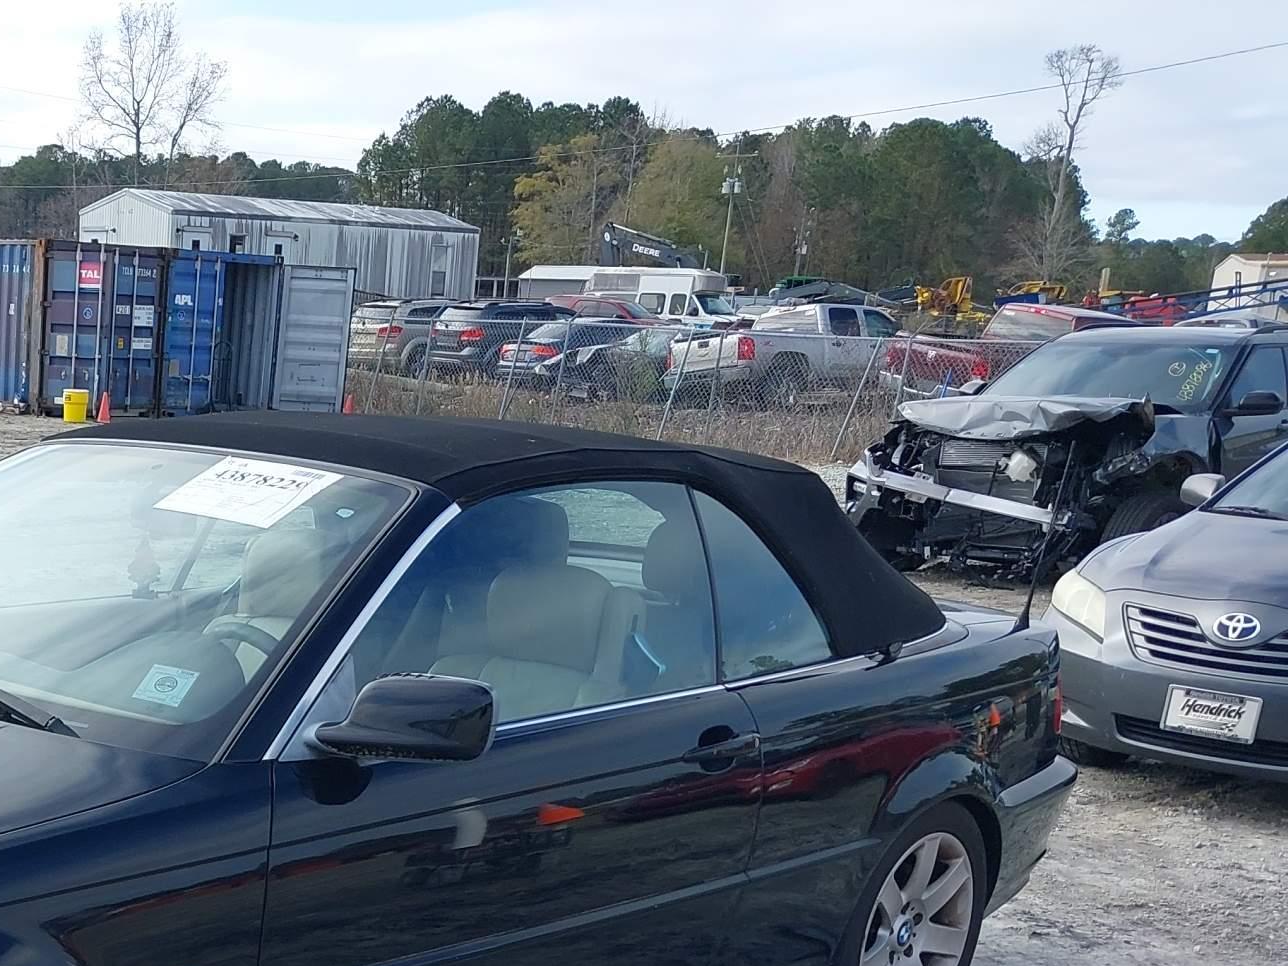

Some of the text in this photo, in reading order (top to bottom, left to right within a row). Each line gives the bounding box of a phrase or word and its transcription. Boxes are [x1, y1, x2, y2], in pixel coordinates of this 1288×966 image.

[632, 243, 661, 257] DEERE
[80, 269, 101, 279] TAL
[174, 294, 194, 306] APL
[215, 469, 310, 490] 43878229
[1180, 698, 1247, 720] Hendrick
